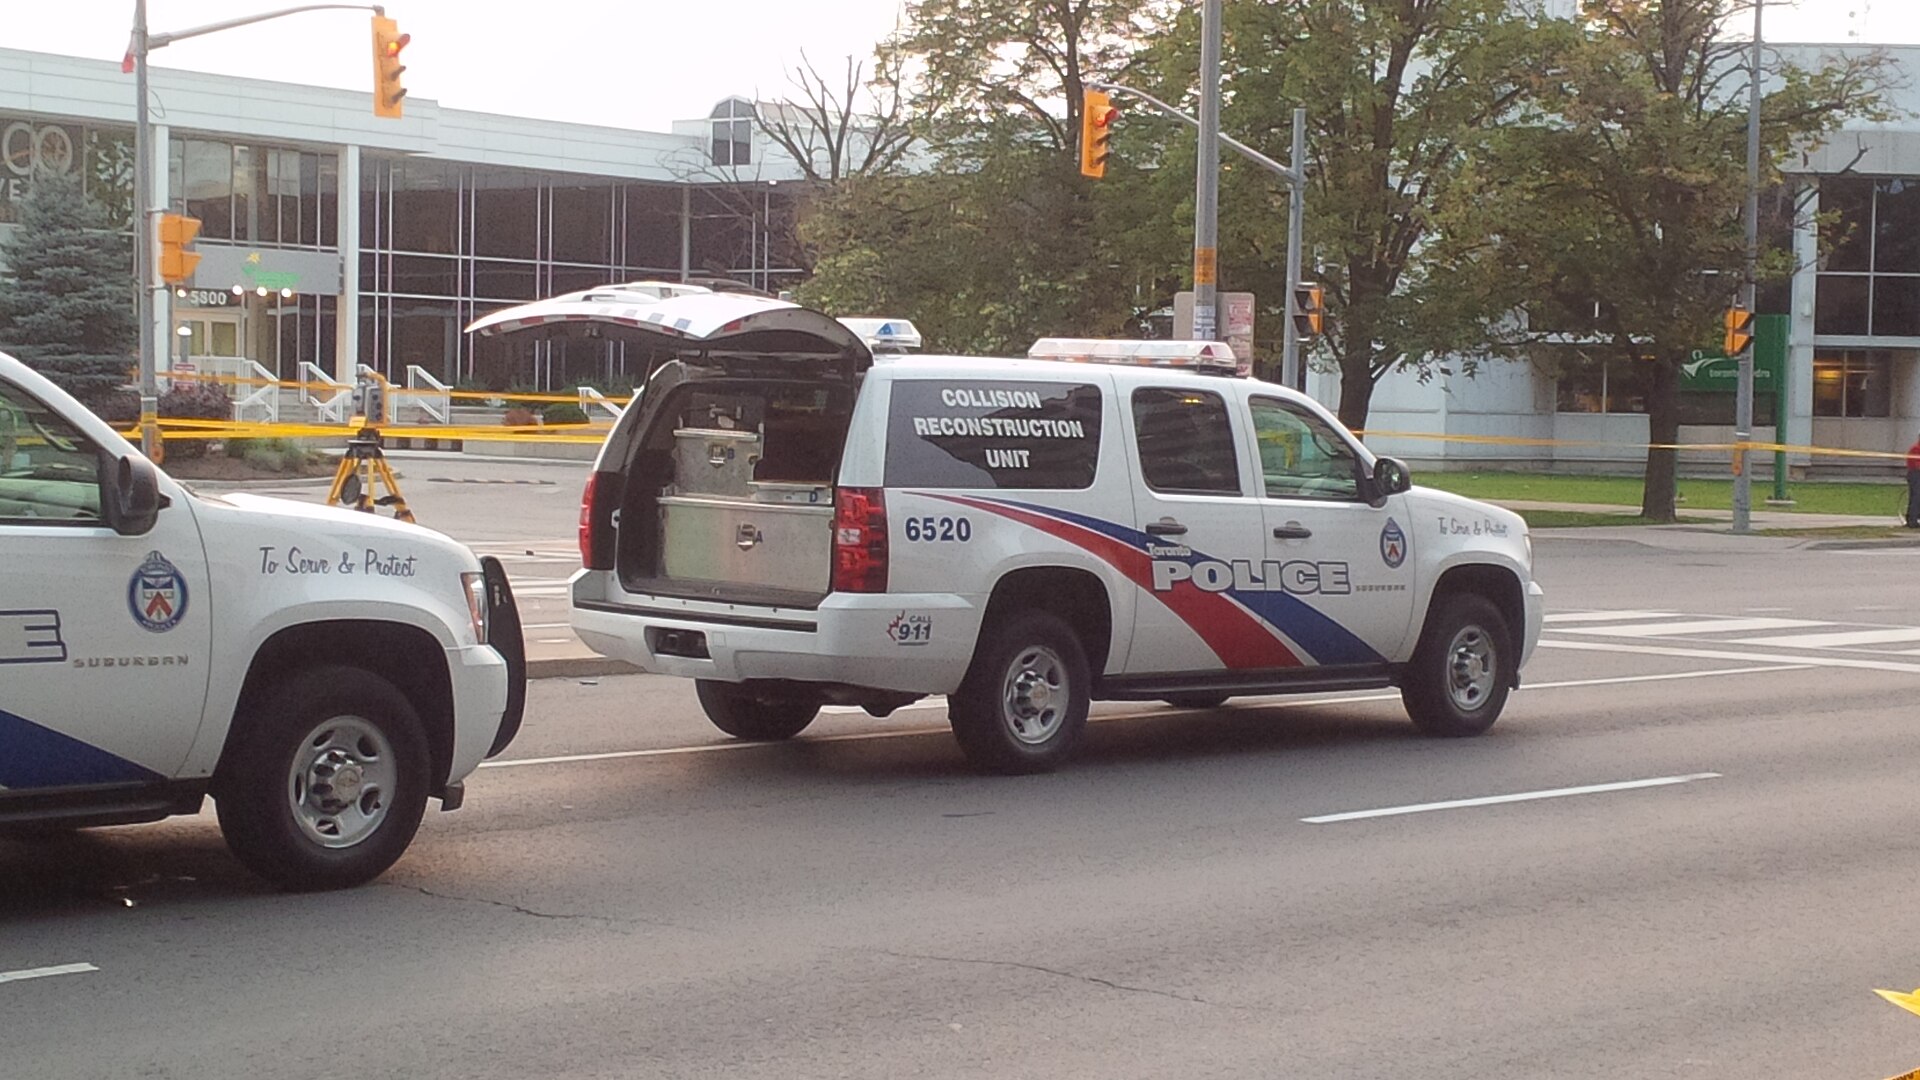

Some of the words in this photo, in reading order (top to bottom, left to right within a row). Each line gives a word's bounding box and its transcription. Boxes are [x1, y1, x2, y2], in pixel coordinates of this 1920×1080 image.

[190, 290, 227, 305] 5800
[941, 389, 1042, 409] COLLISION
[914, 417, 1085, 438] RECONSTRUCTION
[986, 449, 1030, 468] UNIT
[809, 491, 818, 503] D
[905, 517, 971, 541] 6520
[1438, 517, 1448, 535] To
[1473, 520, 1482, 535] &
[755, 530, 764, 544] A
[1146, 542, 1192, 558] Toronto
[259, 546, 279, 574] To
[285, 546, 331, 575] Serve
[338, 551, 356, 574] &
[365, 548, 417, 576] Protect
[1151, 559, 1351, 595] POLICE
[909, 615, 932, 623] CALL
[73, 654, 190, 668] SUBURBAN
